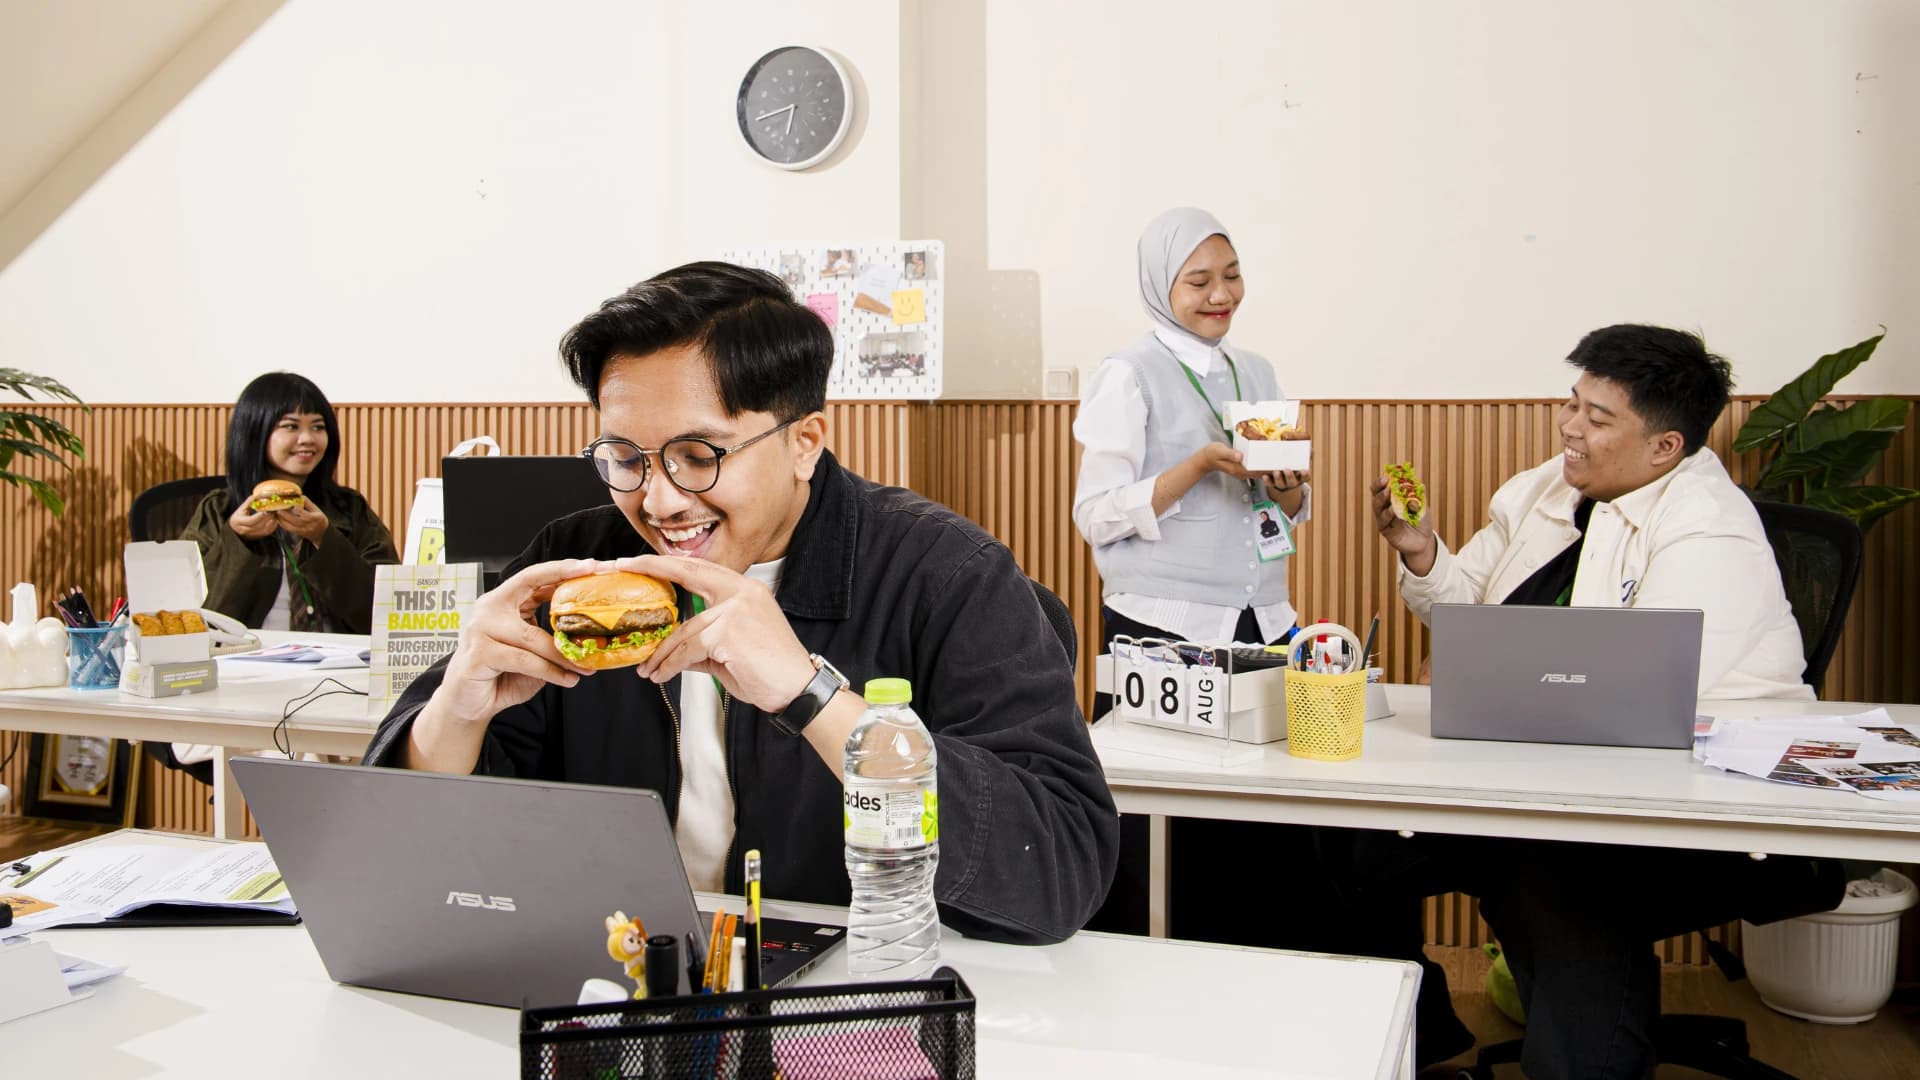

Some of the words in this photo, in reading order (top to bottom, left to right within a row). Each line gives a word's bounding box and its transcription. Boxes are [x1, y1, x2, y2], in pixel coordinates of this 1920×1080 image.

[394, 590, 436, 611] THIS
[441, 590, 456, 610] IS
[387, 612, 460, 630] BANGOR
[387, 640, 459, 653] BURGERNYA
[1540, 673, 1586, 683] ASUS
[1197, 679, 1214, 724] AUG
[844, 791, 881, 812] ades
[446, 891, 517, 912] ASUS
